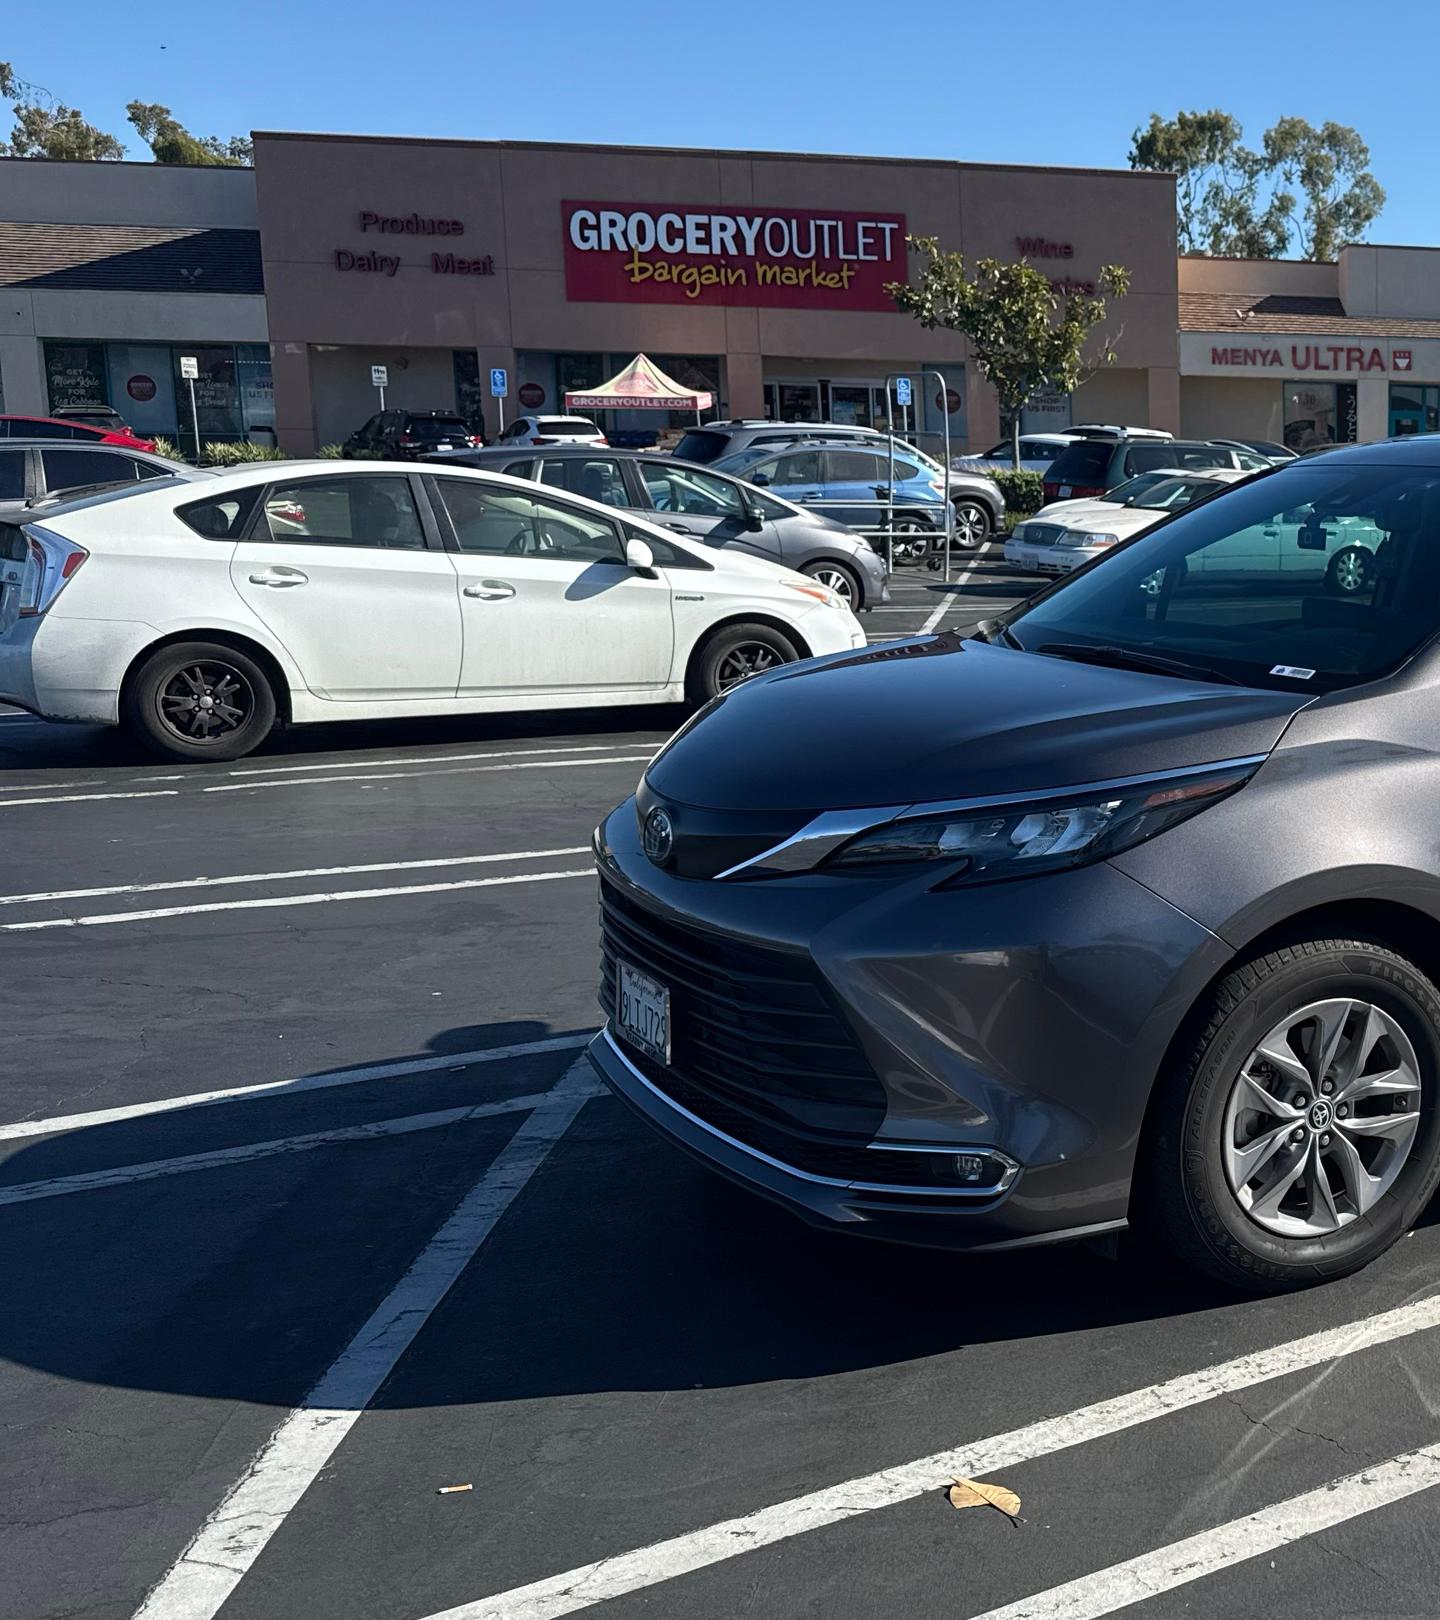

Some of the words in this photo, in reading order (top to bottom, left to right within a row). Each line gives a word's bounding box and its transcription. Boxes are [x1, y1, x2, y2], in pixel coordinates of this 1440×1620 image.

[359, 210, 464, 236] Produce
[570, 209, 898, 262] GROCERYOUTLET
[1016, 236, 1074, 258] Wine
[335, 249, 401, 277] Dairy
[431, 253, 495, 276] Meat
[624, 244, 747, 299] bargain
[756, 261, 855, 290] market
[1211, 347, 1284, 367] MENYA
[1291, 345, 1386, 372] ULTRA
[571, 396, 693, 408] GROCERYOUTLET.COM
